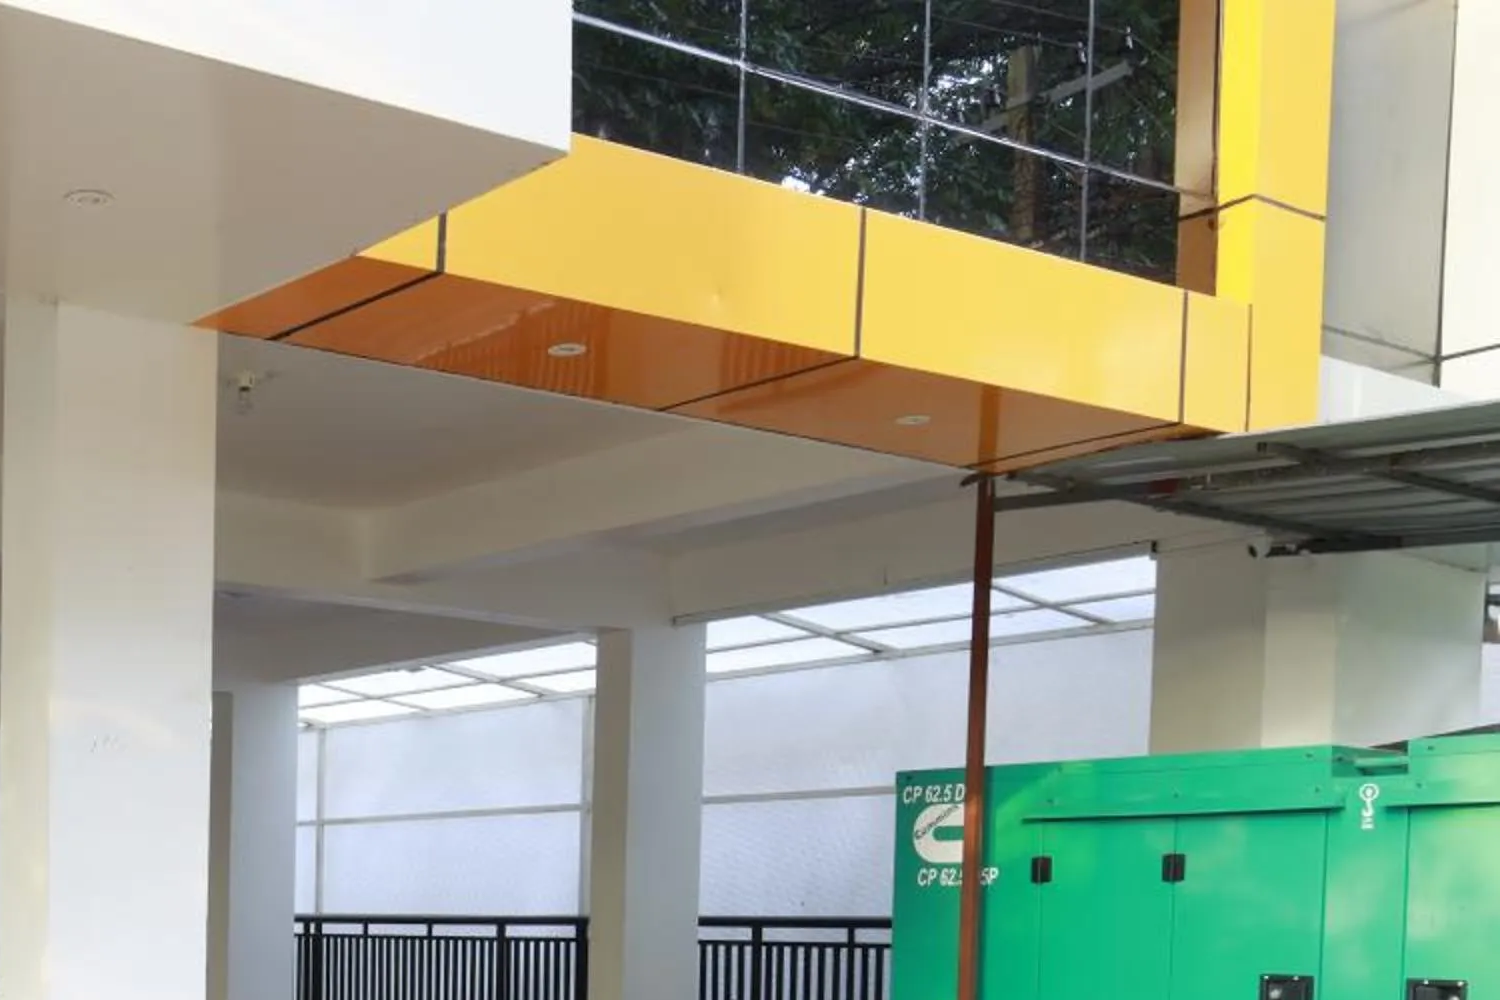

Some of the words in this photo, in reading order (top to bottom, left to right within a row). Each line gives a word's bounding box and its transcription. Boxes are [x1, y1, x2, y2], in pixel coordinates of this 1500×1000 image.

[903, 785, 922, 804] CP
[925, 783, 953, 803] 62.5
[917, 867, 938, 887] CP
